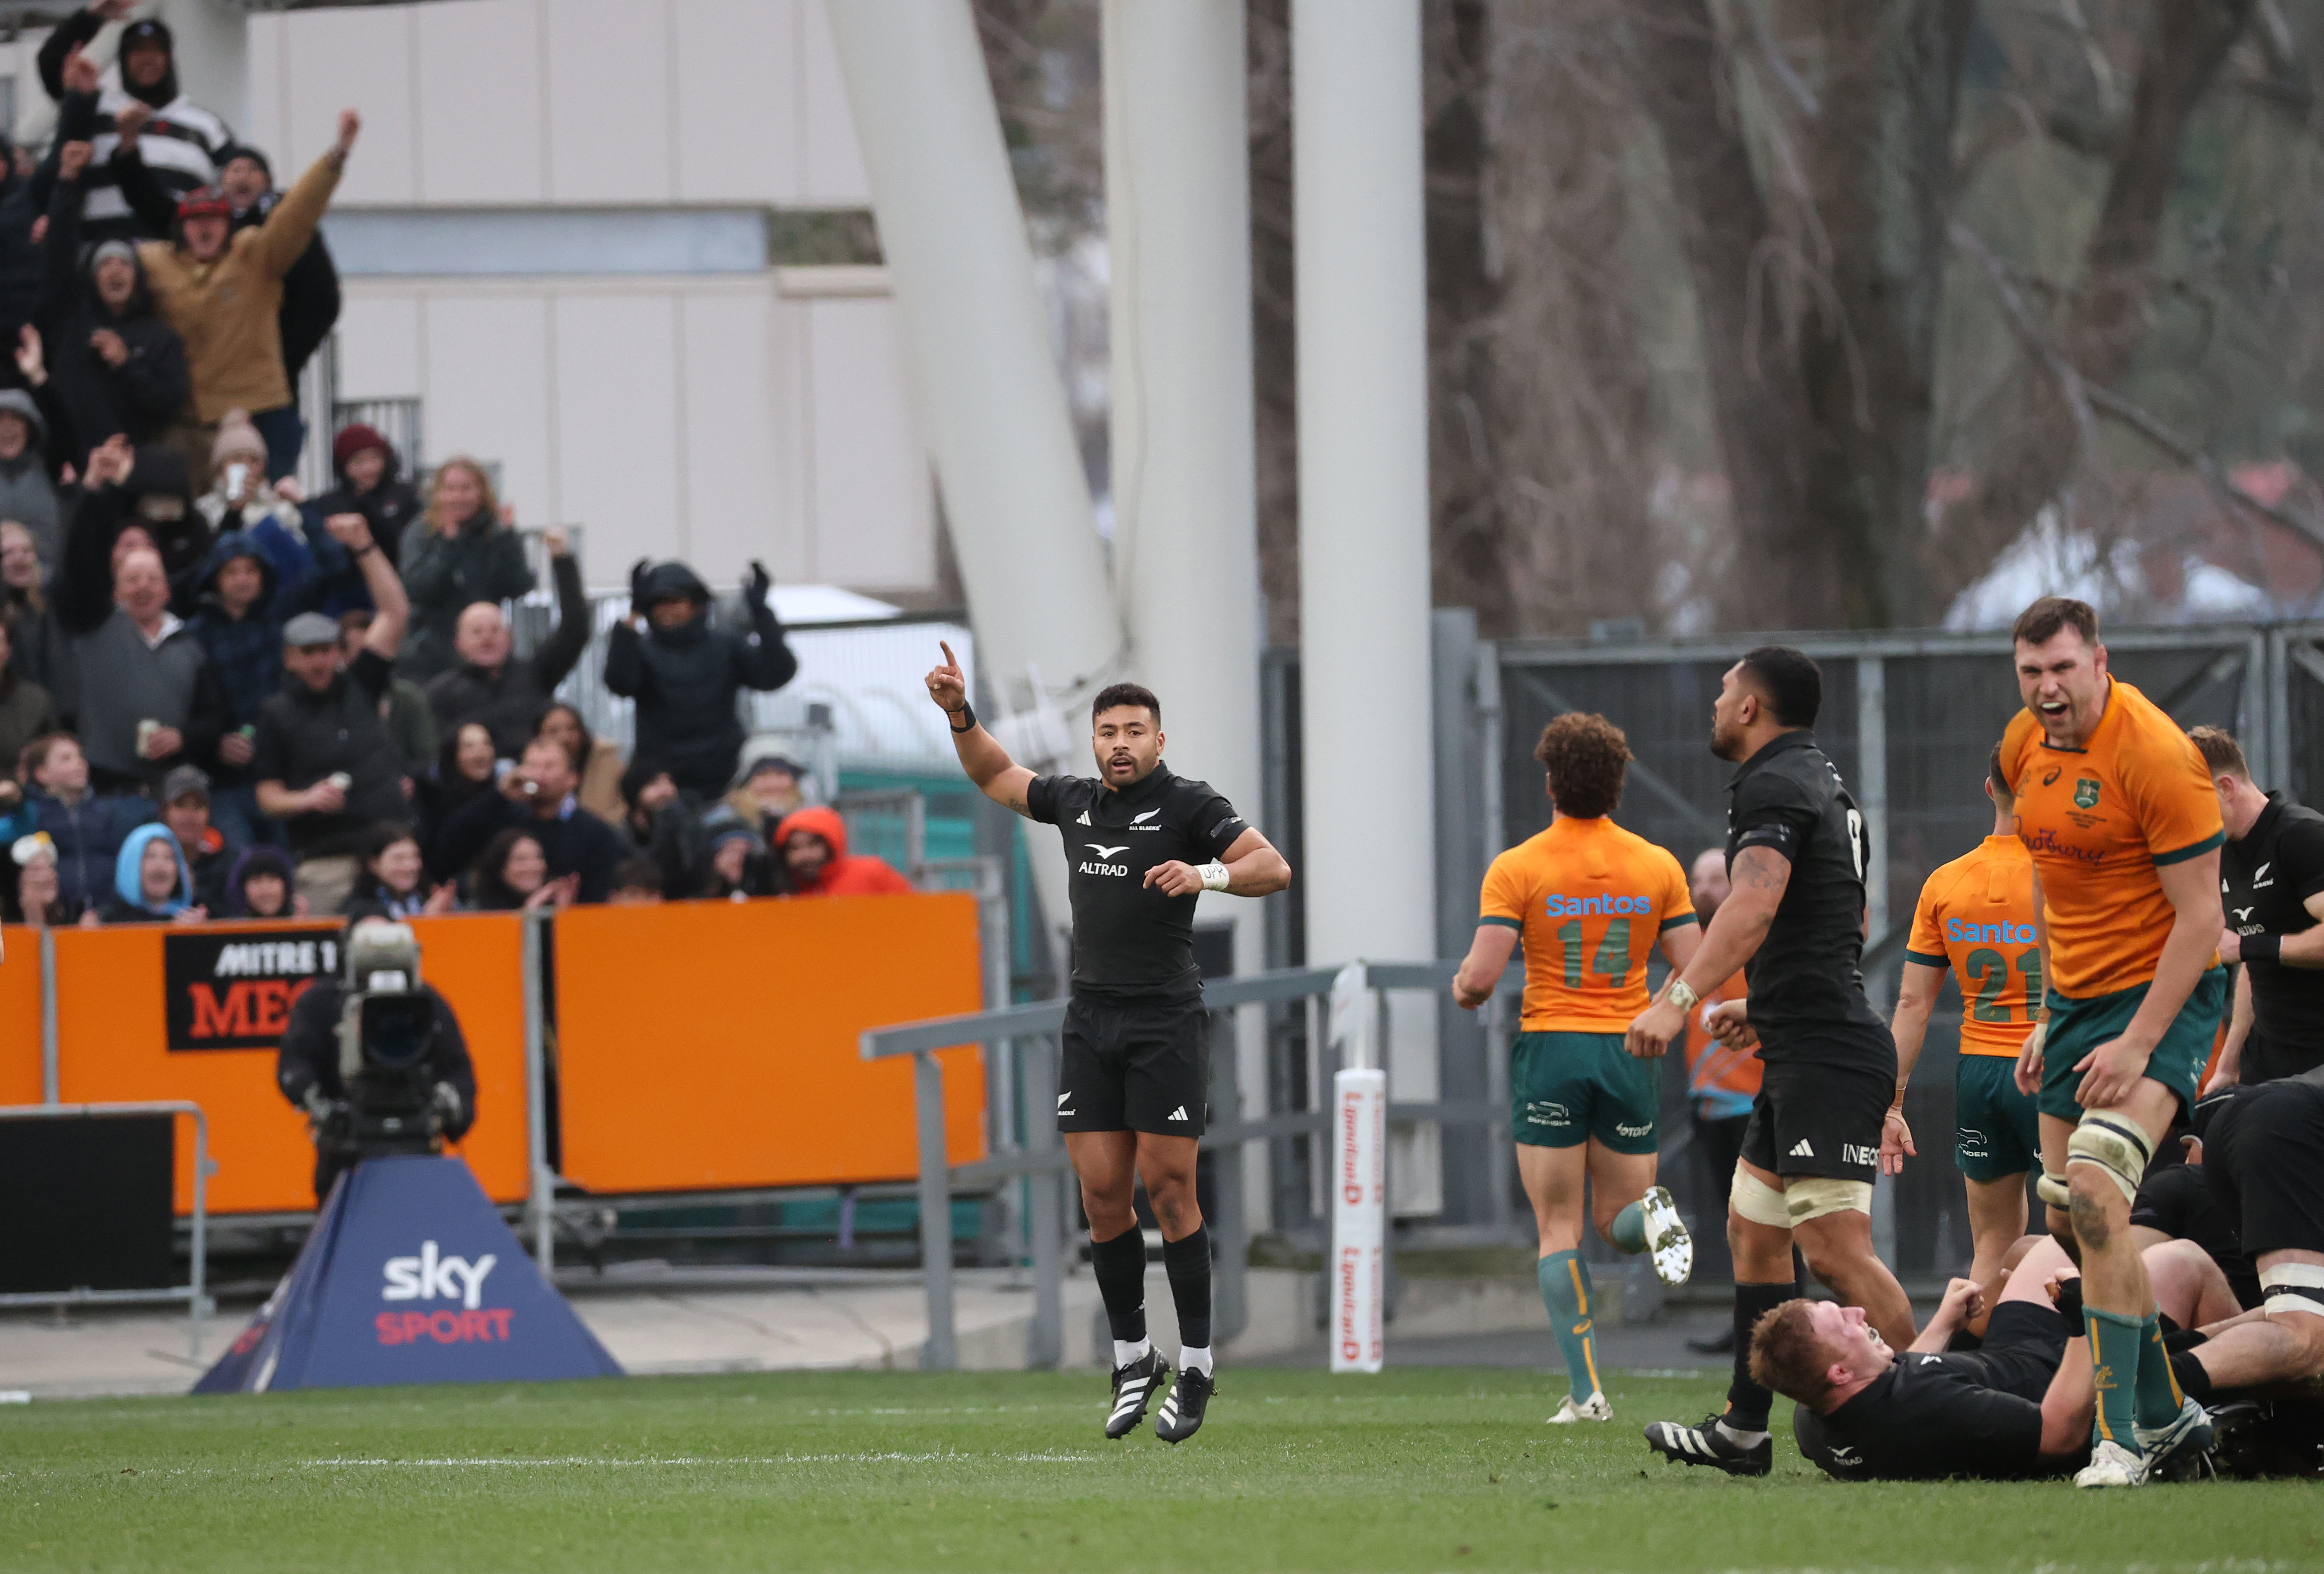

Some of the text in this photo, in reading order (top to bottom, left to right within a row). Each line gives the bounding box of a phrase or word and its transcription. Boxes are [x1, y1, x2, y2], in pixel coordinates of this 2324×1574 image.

[1078, 861, 1128, 877] ALTRAD
[1201, 865, 1227, 879] UPR
[1546, 892, 1651, 917] Santos
[1948, 918, 2036, 944] Santo
[214, 941, 317, 977] MITRE
[1558, 919, 1633, 989] 14
[1967, 948, 2042, 1023] 21
[187, 977, 316, 1039] ME
[1843, 1143, 1880, 1166] INEO
[1961, 1148, 1988, 1158] NDER
[382, 1239, 497, 1309] sky
[376, 1308, 515, 1345] SPORT
